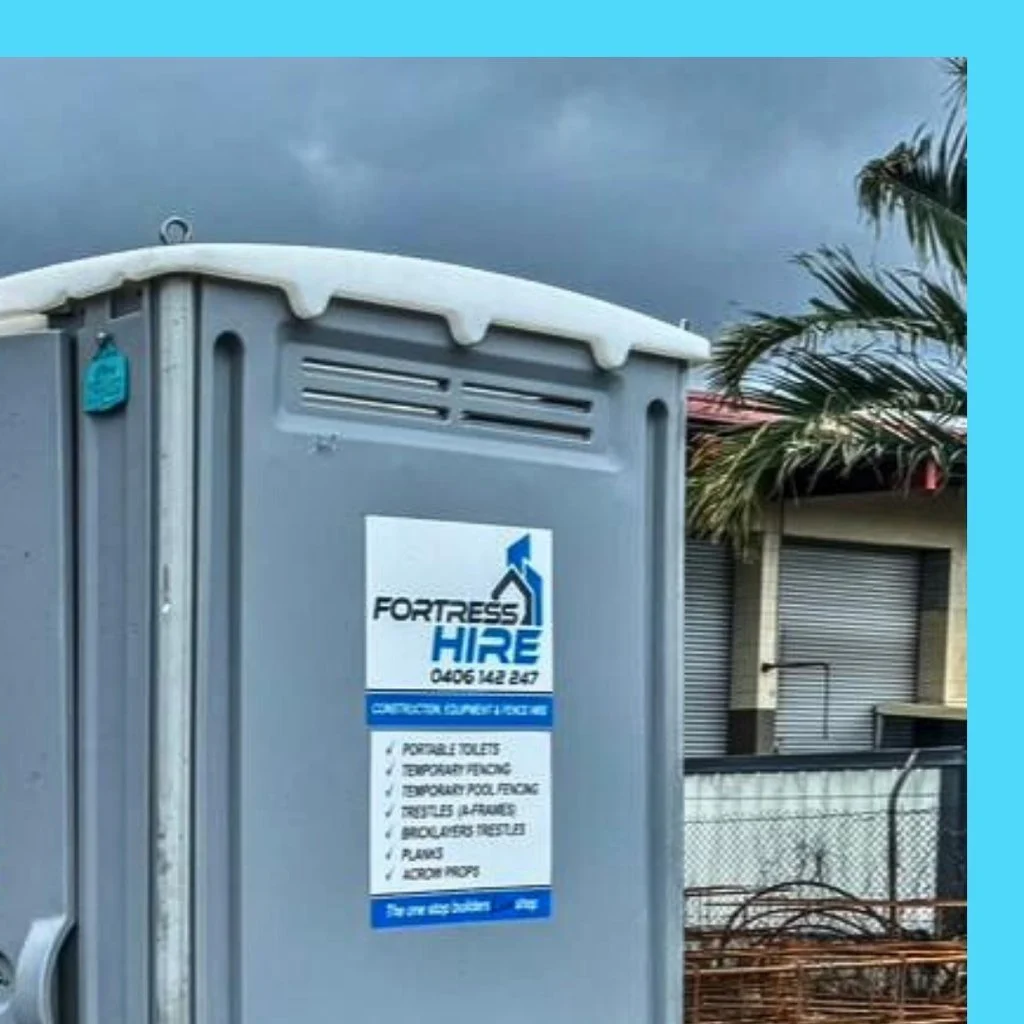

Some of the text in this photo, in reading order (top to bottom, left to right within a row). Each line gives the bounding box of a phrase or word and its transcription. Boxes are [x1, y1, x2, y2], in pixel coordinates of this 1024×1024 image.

[373, 597, 519, 625] FORTRESS
[432, 625, 543, 664] HIRE
[430, 669, 540, 685] 0406 142 247
[401, 742, 501, 756] PORTABLE TOILETS
[402, 763, 512, 777] TEMPORARY FENCING
[402, 783, 539, 797] TEMPORARY POOL FENCING
[401, 804, 454, 819] TRESTLES
[401, 823, 526, 840] BRICKLAYERS TRESTLES
[401, 847, 444, 861] PLANKS
[445, 865, 480, 878] PROPS
